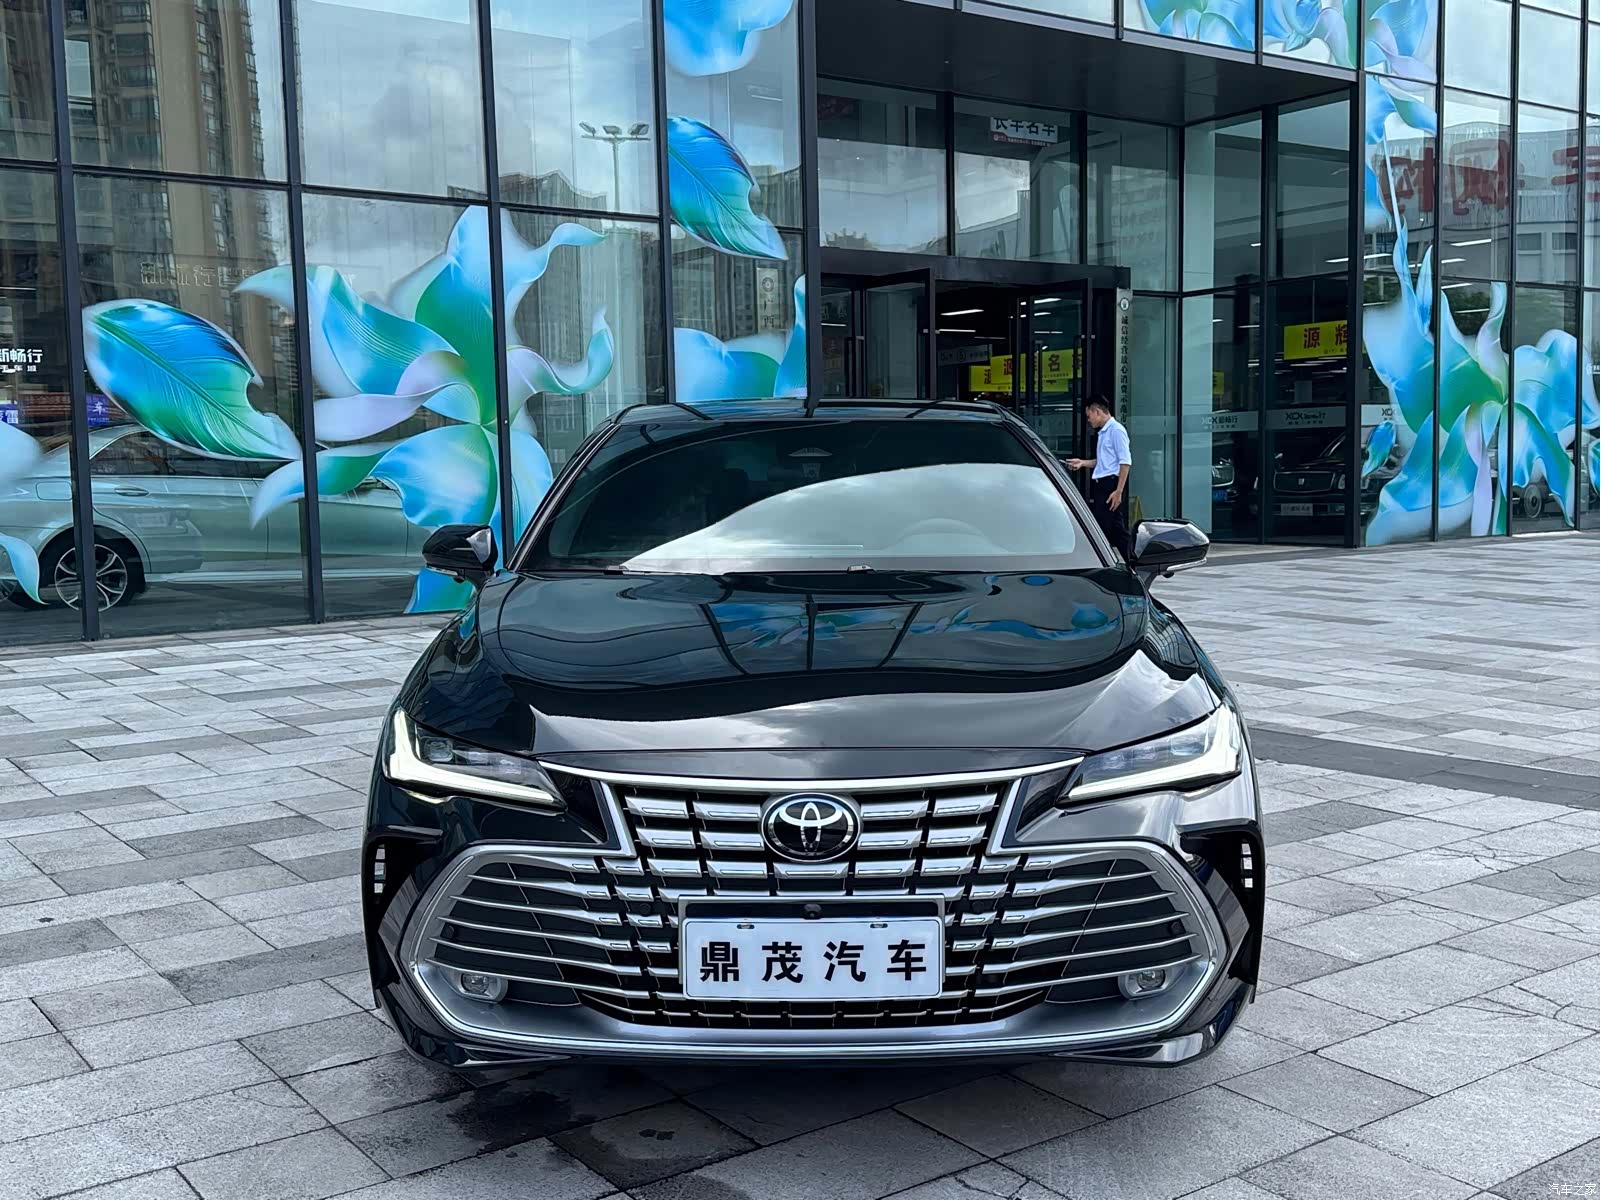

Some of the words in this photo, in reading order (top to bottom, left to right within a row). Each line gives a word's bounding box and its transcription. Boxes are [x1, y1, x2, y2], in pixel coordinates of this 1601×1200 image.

[1120, 315, 1129, 424] 诚信经营放心消费示范市
[700, 939, 927, 983] 鼎茂汽车
